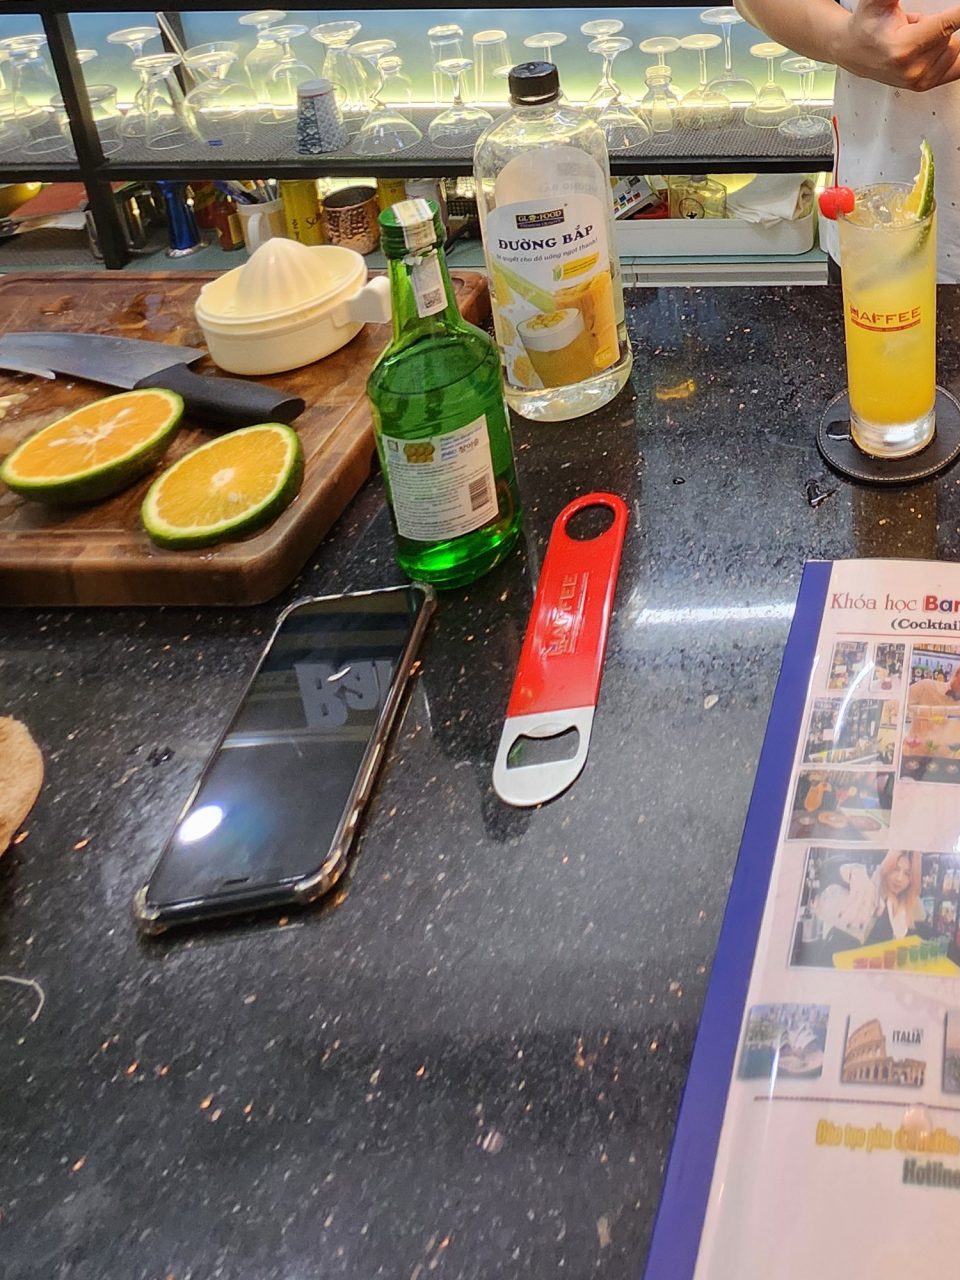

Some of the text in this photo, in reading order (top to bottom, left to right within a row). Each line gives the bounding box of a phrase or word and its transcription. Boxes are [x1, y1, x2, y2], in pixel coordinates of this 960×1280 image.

[498, 237, 557, 251] ĐƯỜNG
[562, 224, 594, 245] BẮP
[830, 592, 877, 610] Khóa
[884, 593, 917, 613] học
[892, 1029, 922, 1045] ITALIA
